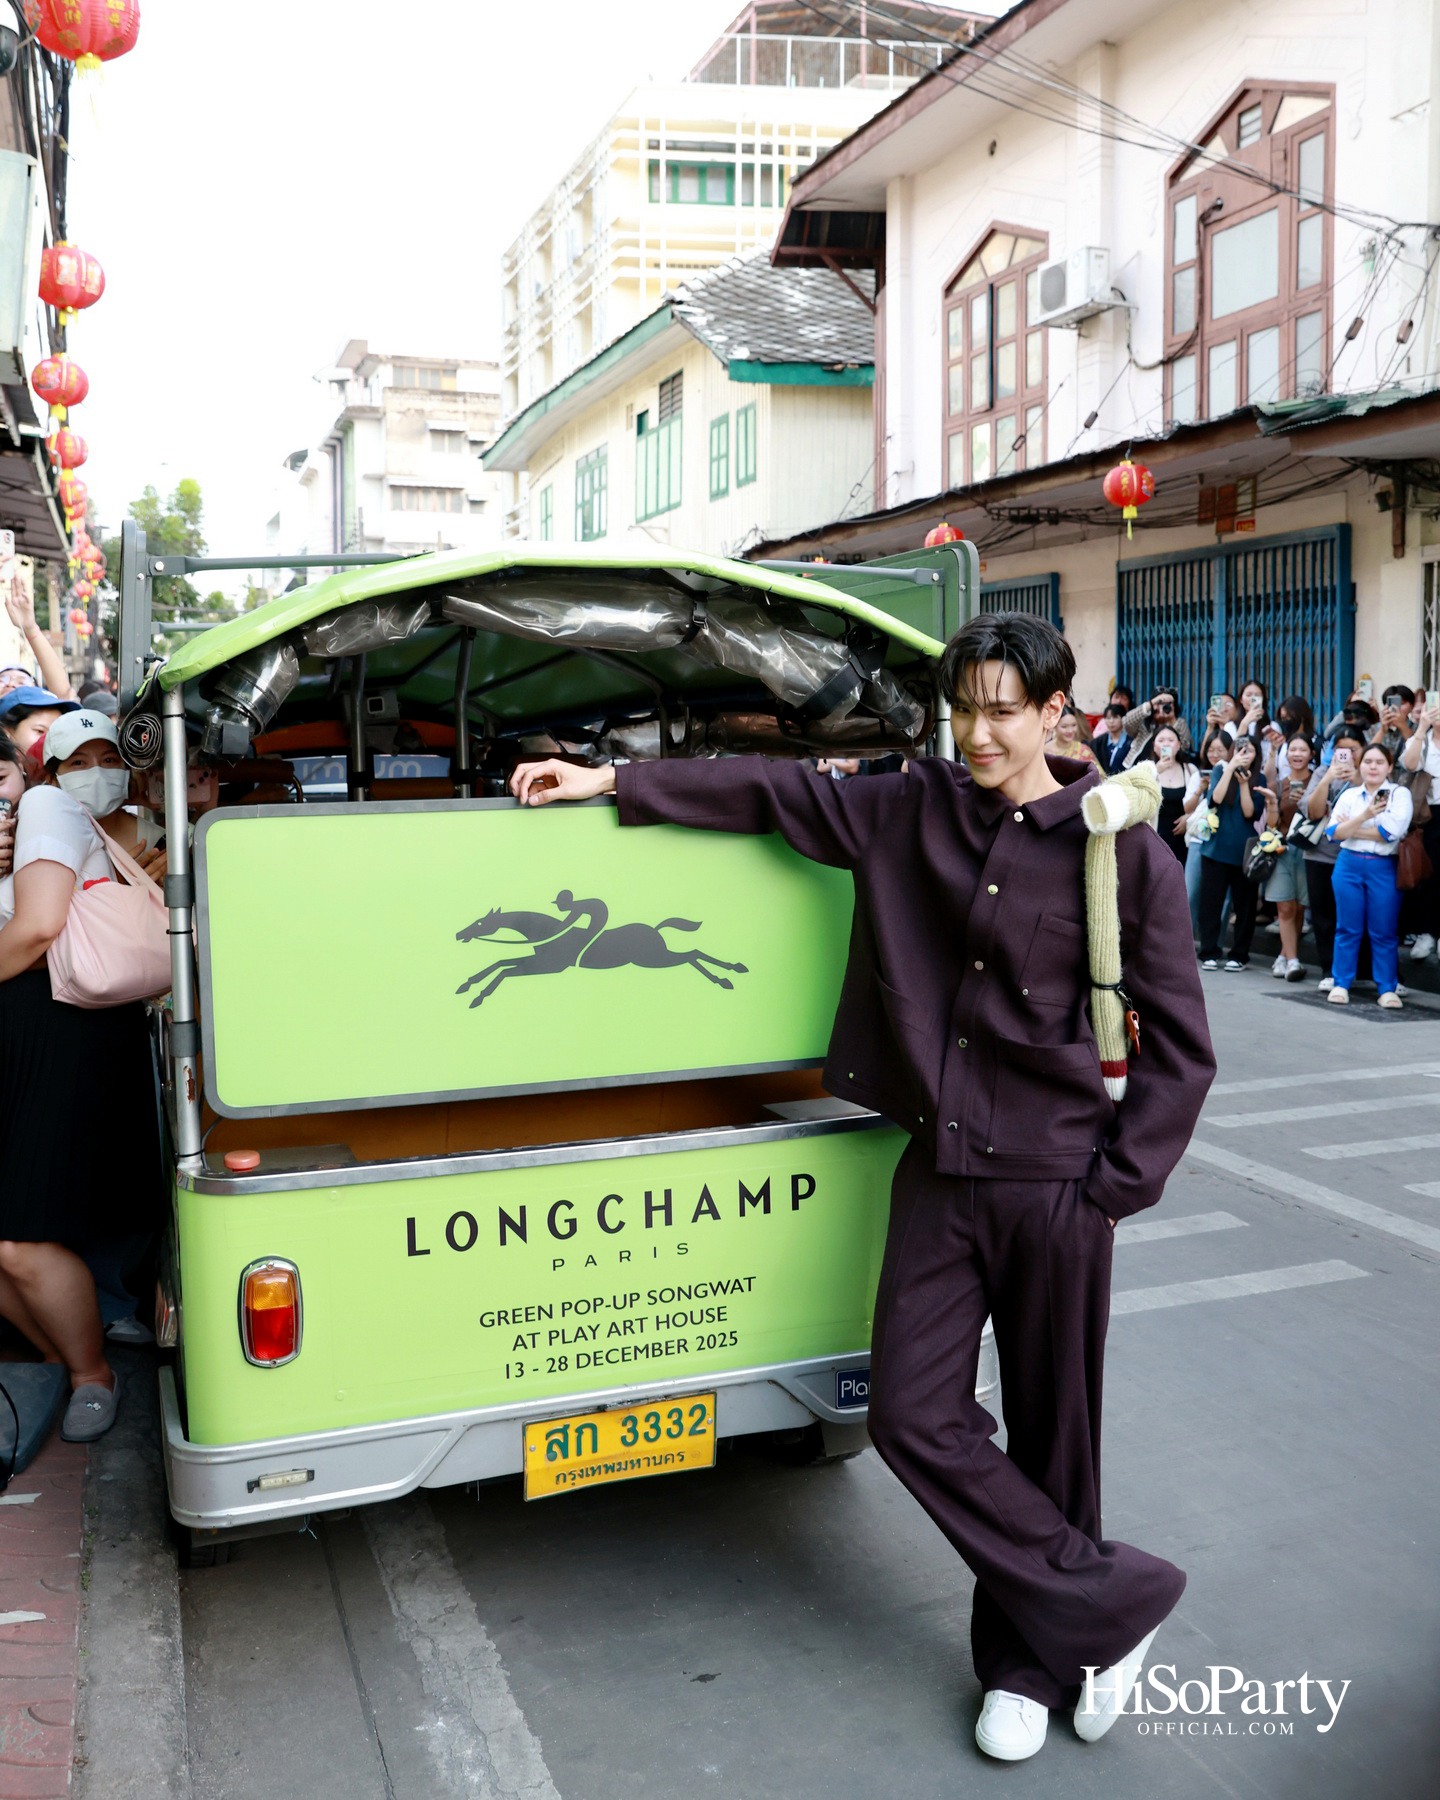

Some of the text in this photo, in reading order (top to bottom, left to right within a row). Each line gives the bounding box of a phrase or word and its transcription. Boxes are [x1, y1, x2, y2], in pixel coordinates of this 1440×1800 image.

[80, 718, 94, 728] LA
[406, 1173, 818, 1257] LONGCHAMP
[552, 1242, 690, 1272] PARIS
[479, 1276, 757, 1328] GREEN POP-UP SONGWAT
[512, 1305, 728, 1352] AT PLAY ART HOUSE
[505, 1361, 525, 1380] 13
[546, 1355, 569, 1374] 28
[576, 1338, 689, 1369] DECEMBER
[695, 1330, 739, 1352] 2025
[841, 1379, 871, 1399] Pla
[545, 1403, 708, 1462] สก 3332
[555, 1450, 686, 1486] กรุงเทพมหานคร
